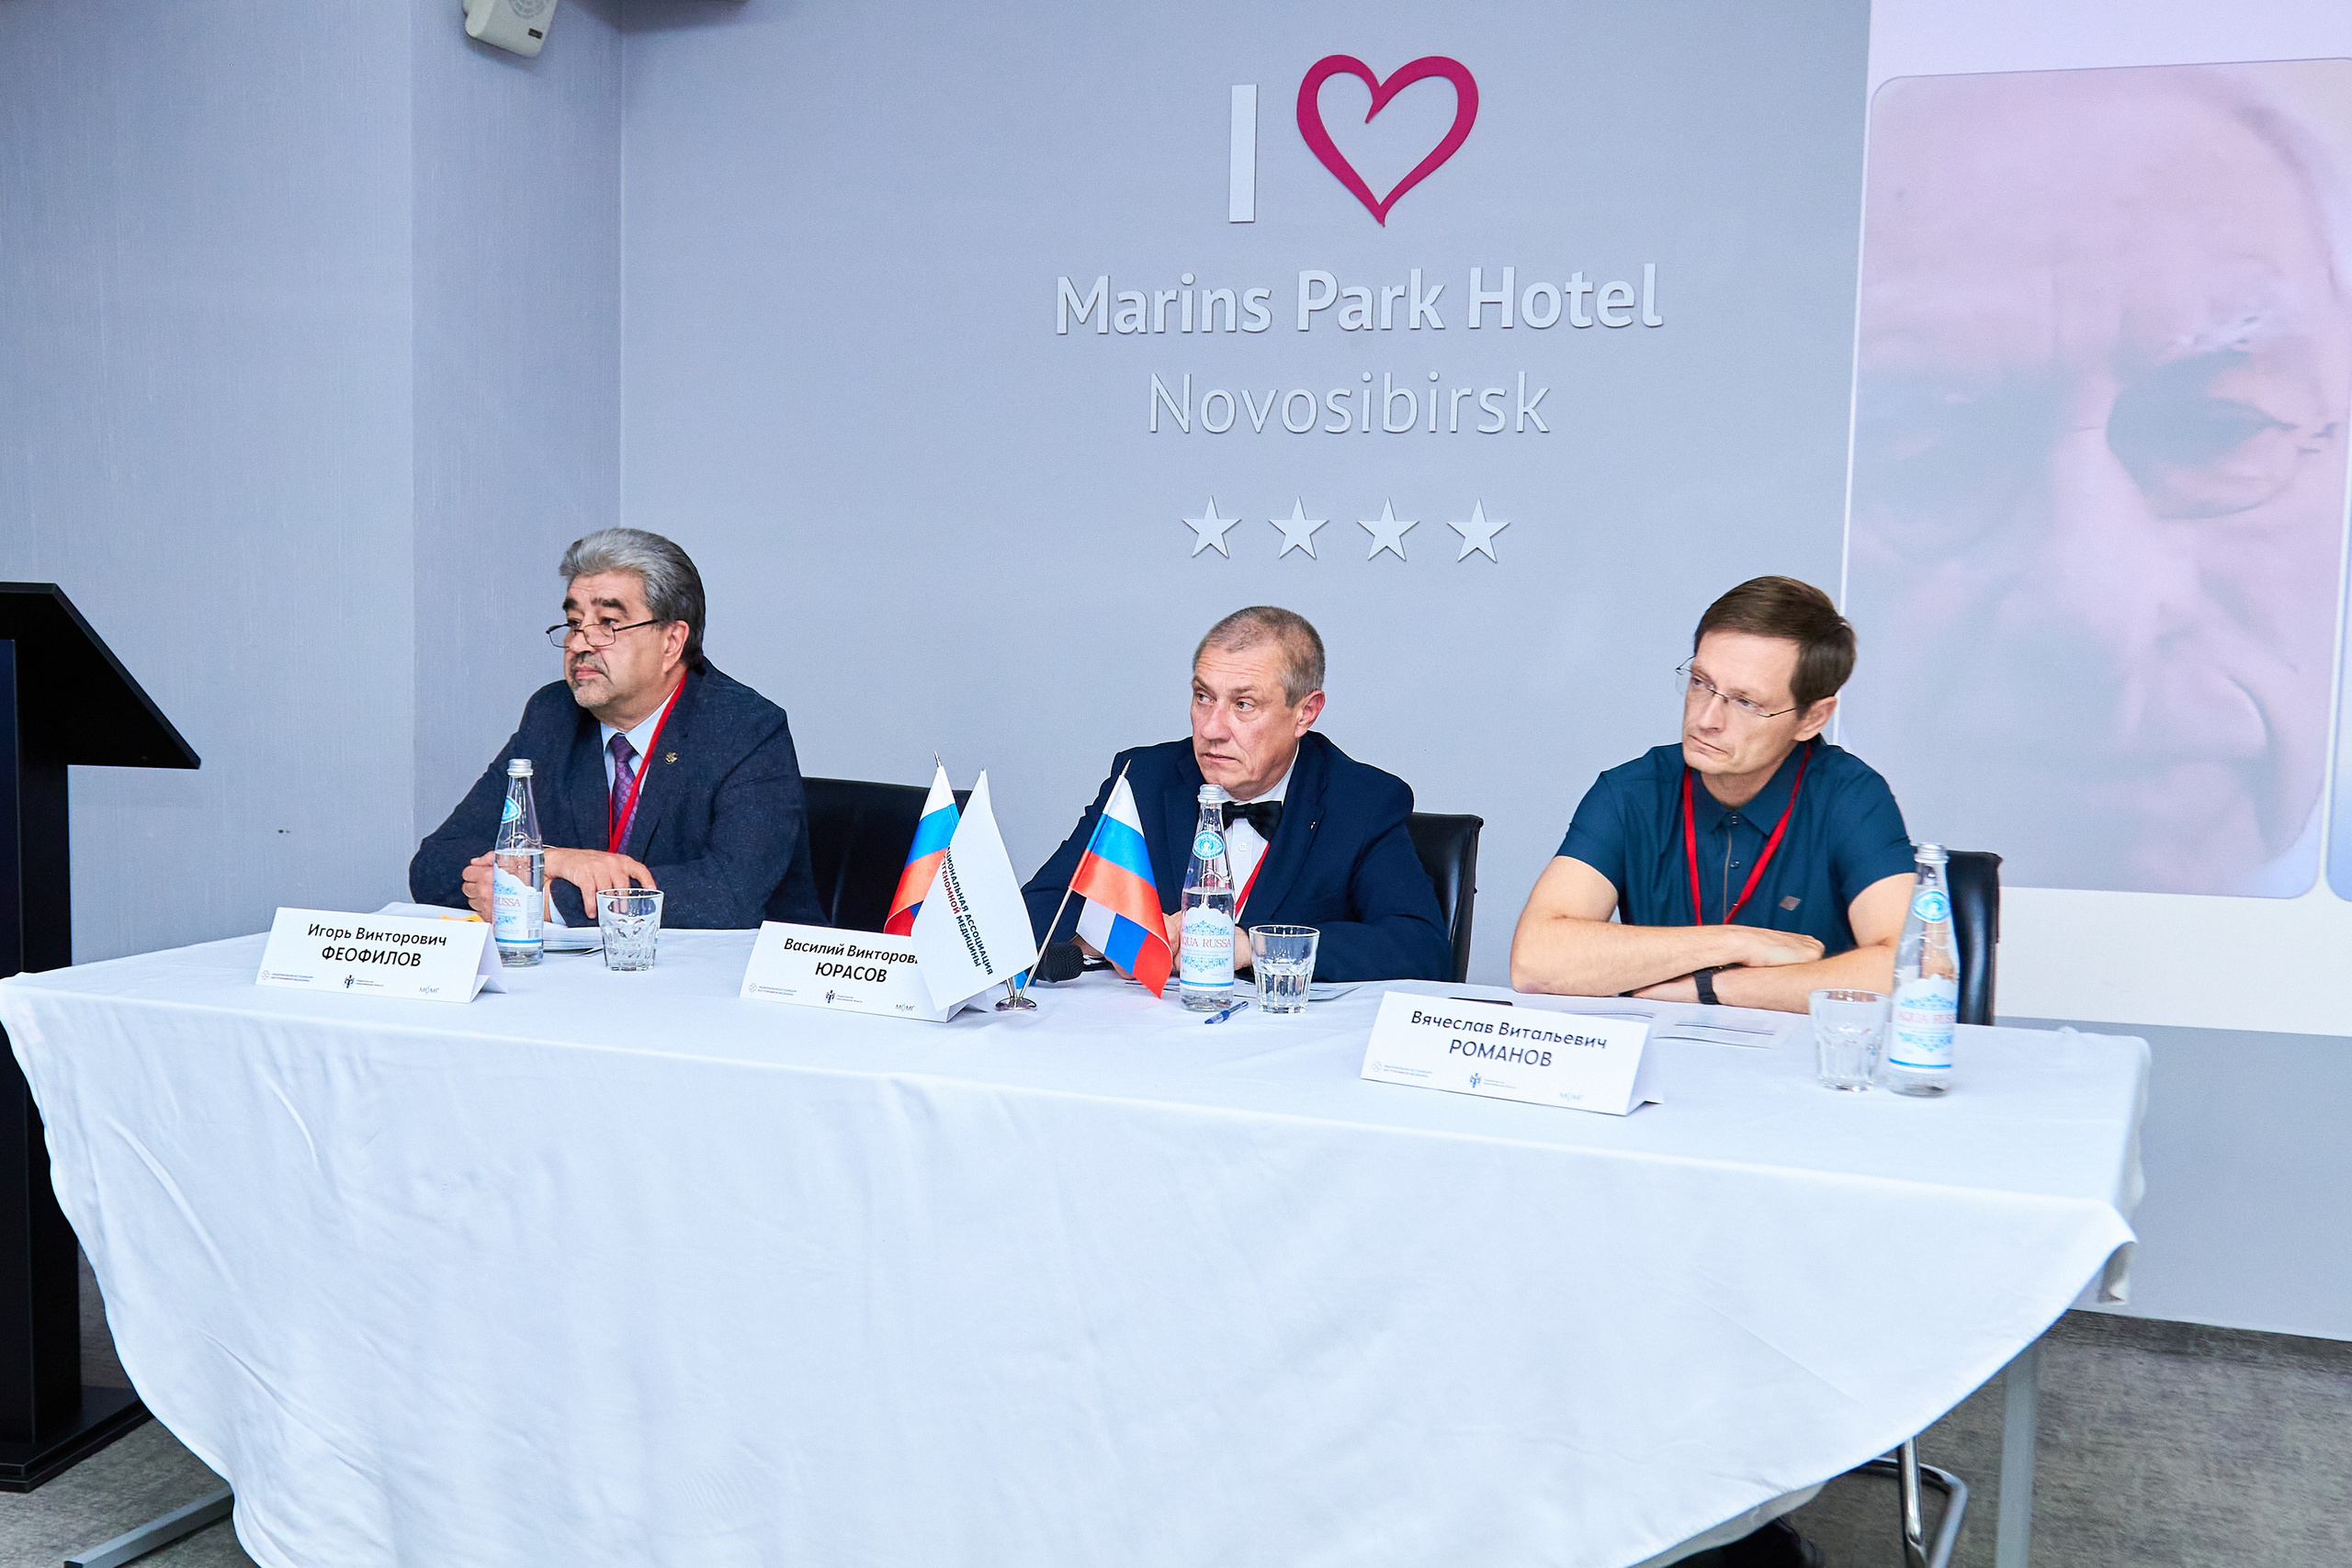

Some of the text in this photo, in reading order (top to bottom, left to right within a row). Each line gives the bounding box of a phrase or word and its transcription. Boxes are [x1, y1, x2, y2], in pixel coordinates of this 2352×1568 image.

[1228, 84, 1258, 223] I
[1056, 263, 1665, 335] Marins Park Hotel
[1148, 371, 1551, 434] Novosibirsk
[946, 842, 994, 976] ЦИОНАЛЬНАЯ АССОЦИАЦИЯ
[308, 923, 447, 947] Игорь Викторович
[784, 937, 919, 965] Василий Викторов
[956, 915, 982, 967] МЕДИЦИНЫ
[1203, 939, 1231, 948] RUSSA
[322, 945, 422, 967] ФЕОФИЛОВ
[815, 962, 888, 983] ЮРАСОВ
[1410, 1010, 1608, 1049] Вячеслав Витальевич
[1448, 1039, 1553, 1067] РОМАНОВ
